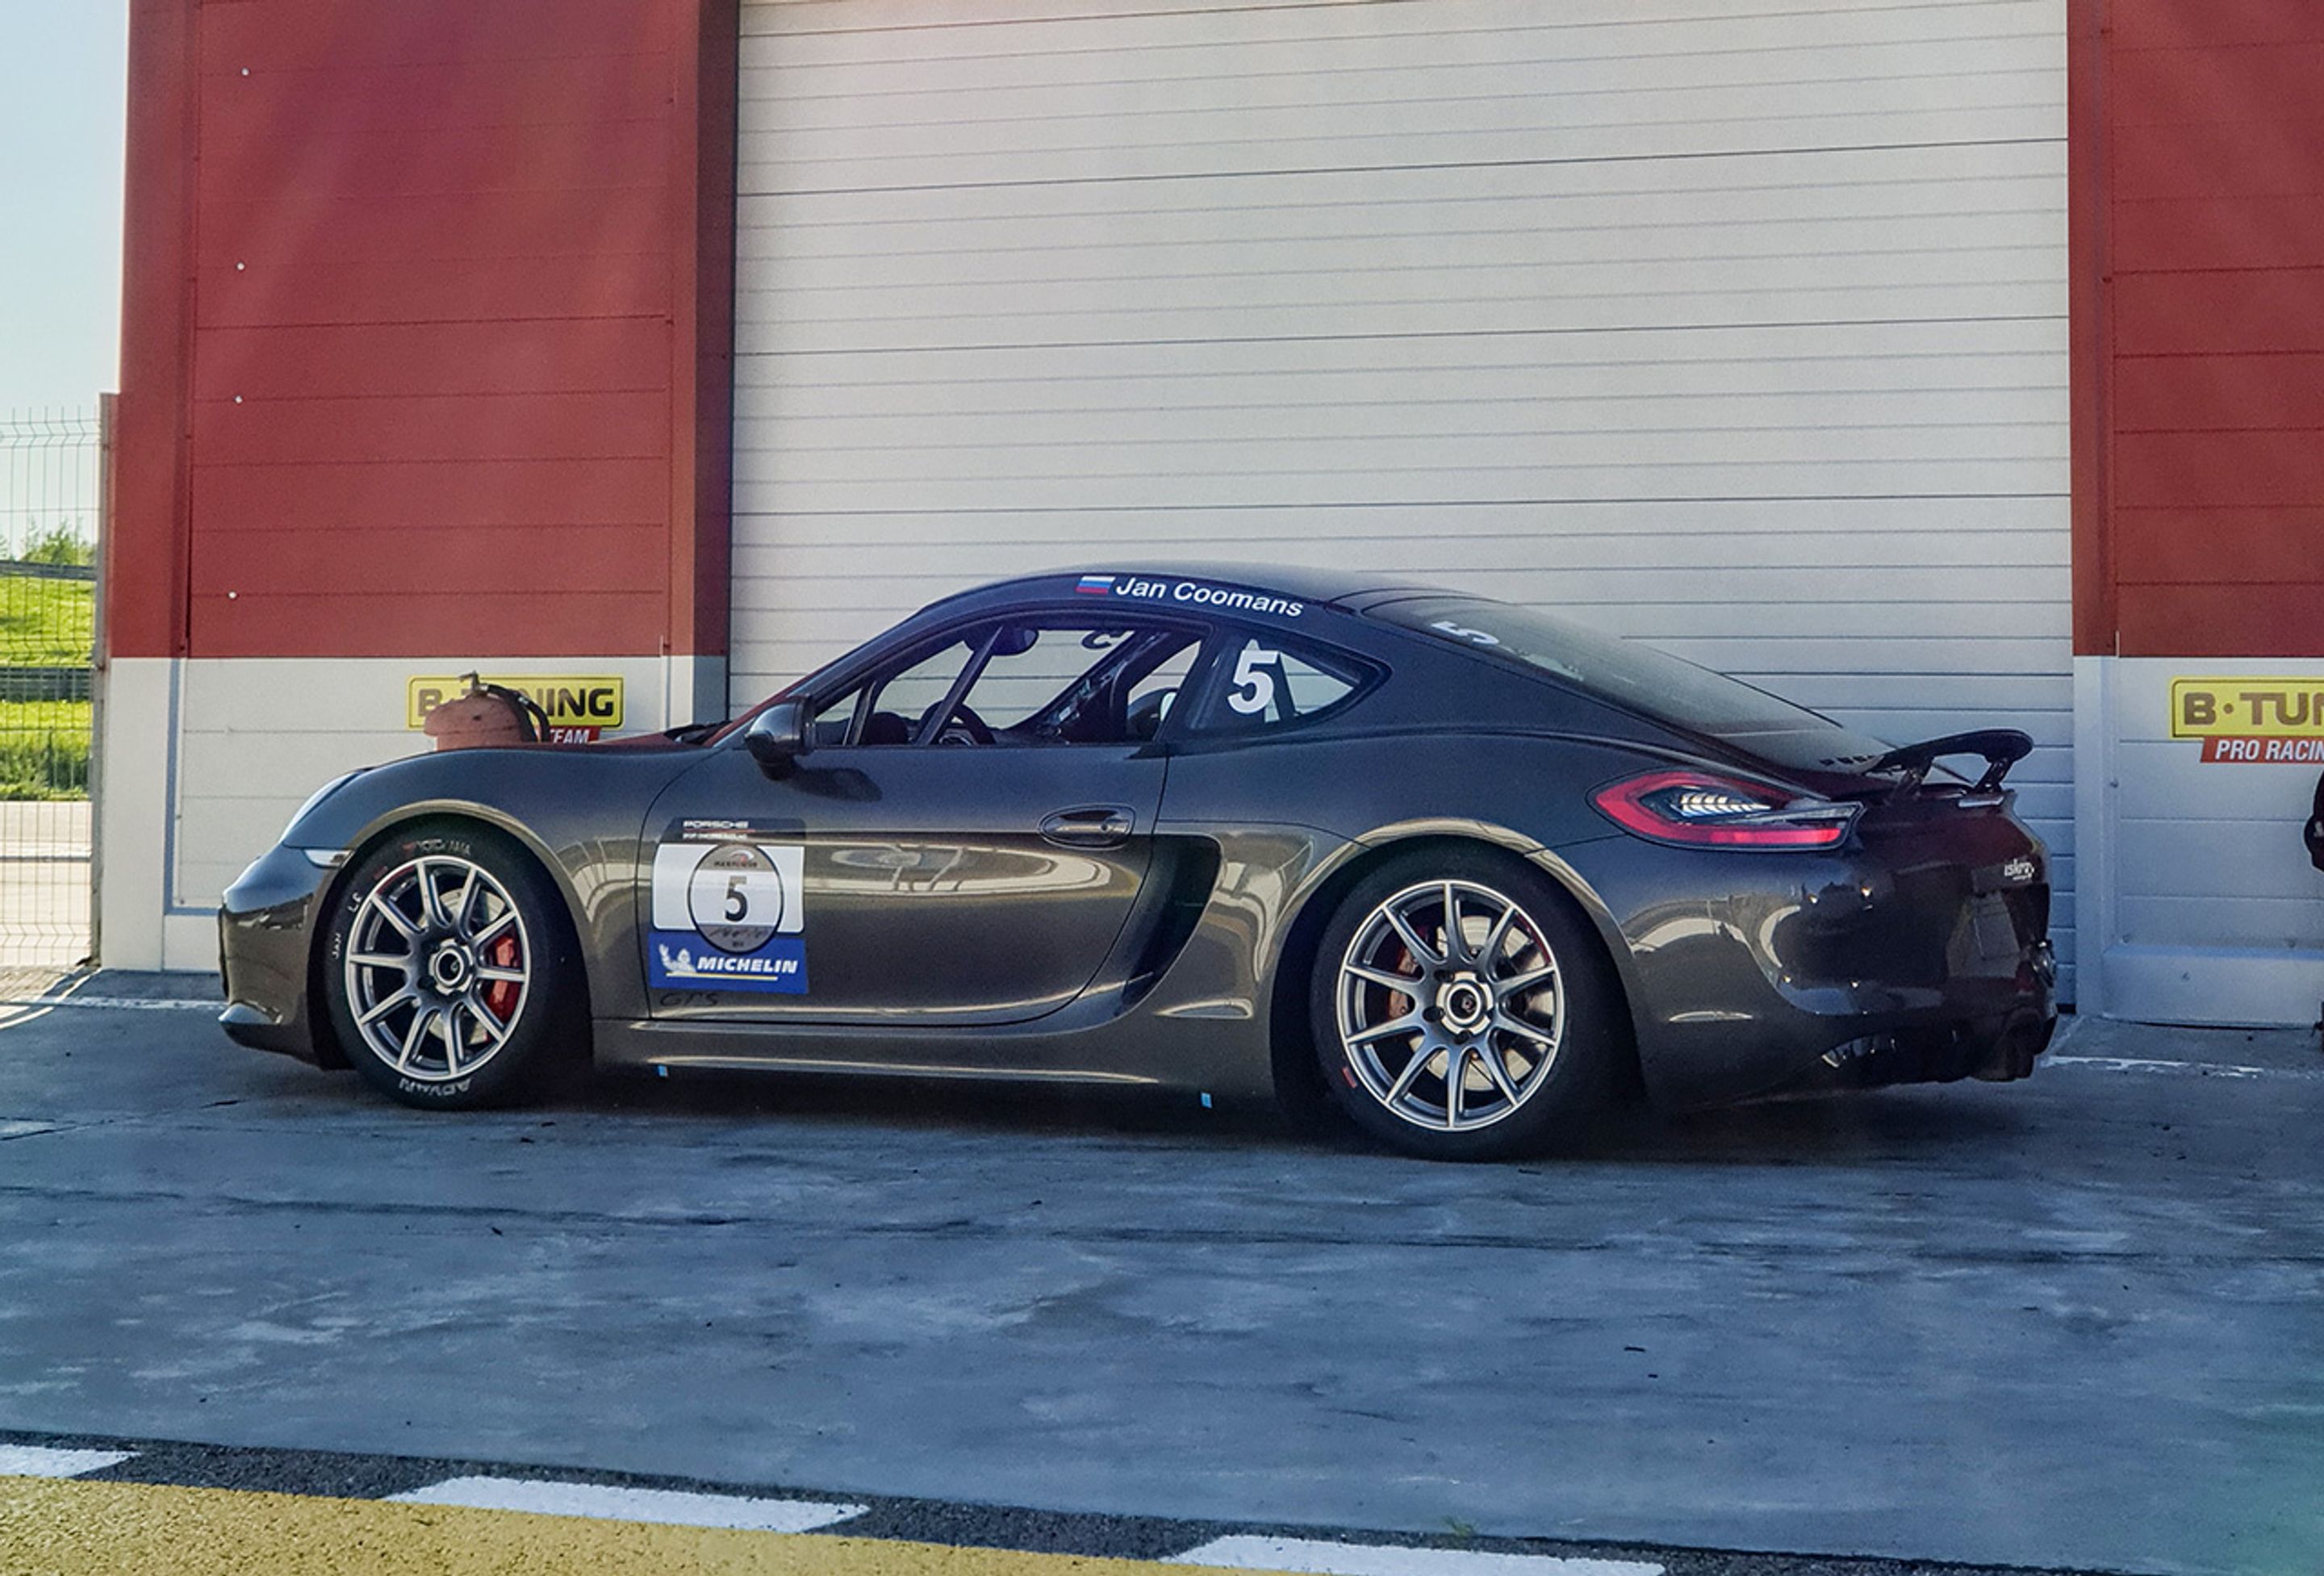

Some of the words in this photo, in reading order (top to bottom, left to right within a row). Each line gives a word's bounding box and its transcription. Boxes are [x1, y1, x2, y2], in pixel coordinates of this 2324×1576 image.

[1116, 577, 1166, 599] Jan
[1173, 582, 1304, 617] Coomans
[1227, 650, 1280, 715] 5
[2215, 740, 2260, 760] PRO
[725, 876, 747, 922] 5
[697, 956, 798, 974] MICHELIN
